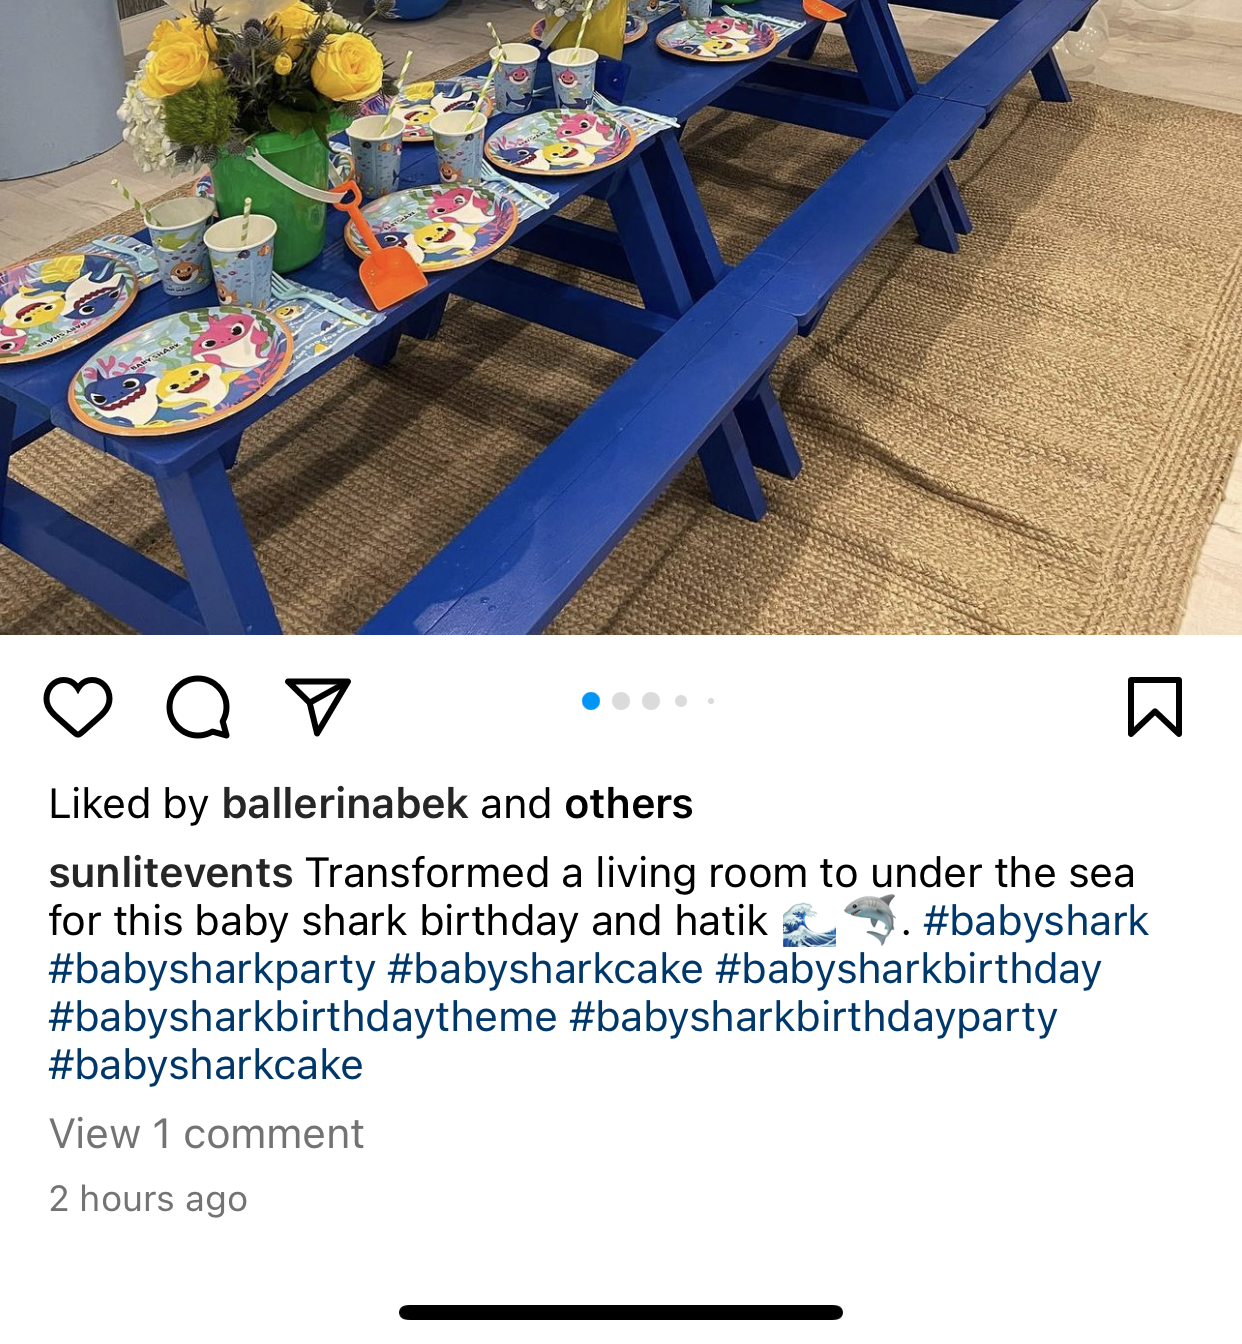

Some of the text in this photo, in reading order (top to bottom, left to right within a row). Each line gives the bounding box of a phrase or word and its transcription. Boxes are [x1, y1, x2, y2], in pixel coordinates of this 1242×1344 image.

[130, 342, 181, 371] BABY SHARK
[51, 786, 692, 826] Liked by ballerinabek and others
[50, 855, 1133, 895] sunlitevents Transformed a living room to under the sea
[49, 904, 1149, 943] for this baby shark birthday and hatik #babyshark
[48, 952, 1101, 991] #babysharkparty #babysharkcake #babysharkbirthday
[48, 1000, 1057, 1039] #babysharkbirthdaytheme #babysharkbirthdayparty
[48, 1048, 362, 1087] #babysharkcake
[50, 1117, 363, 1148] View 1 comment
[51, 1184, 246, 1218] 2 hours ago
